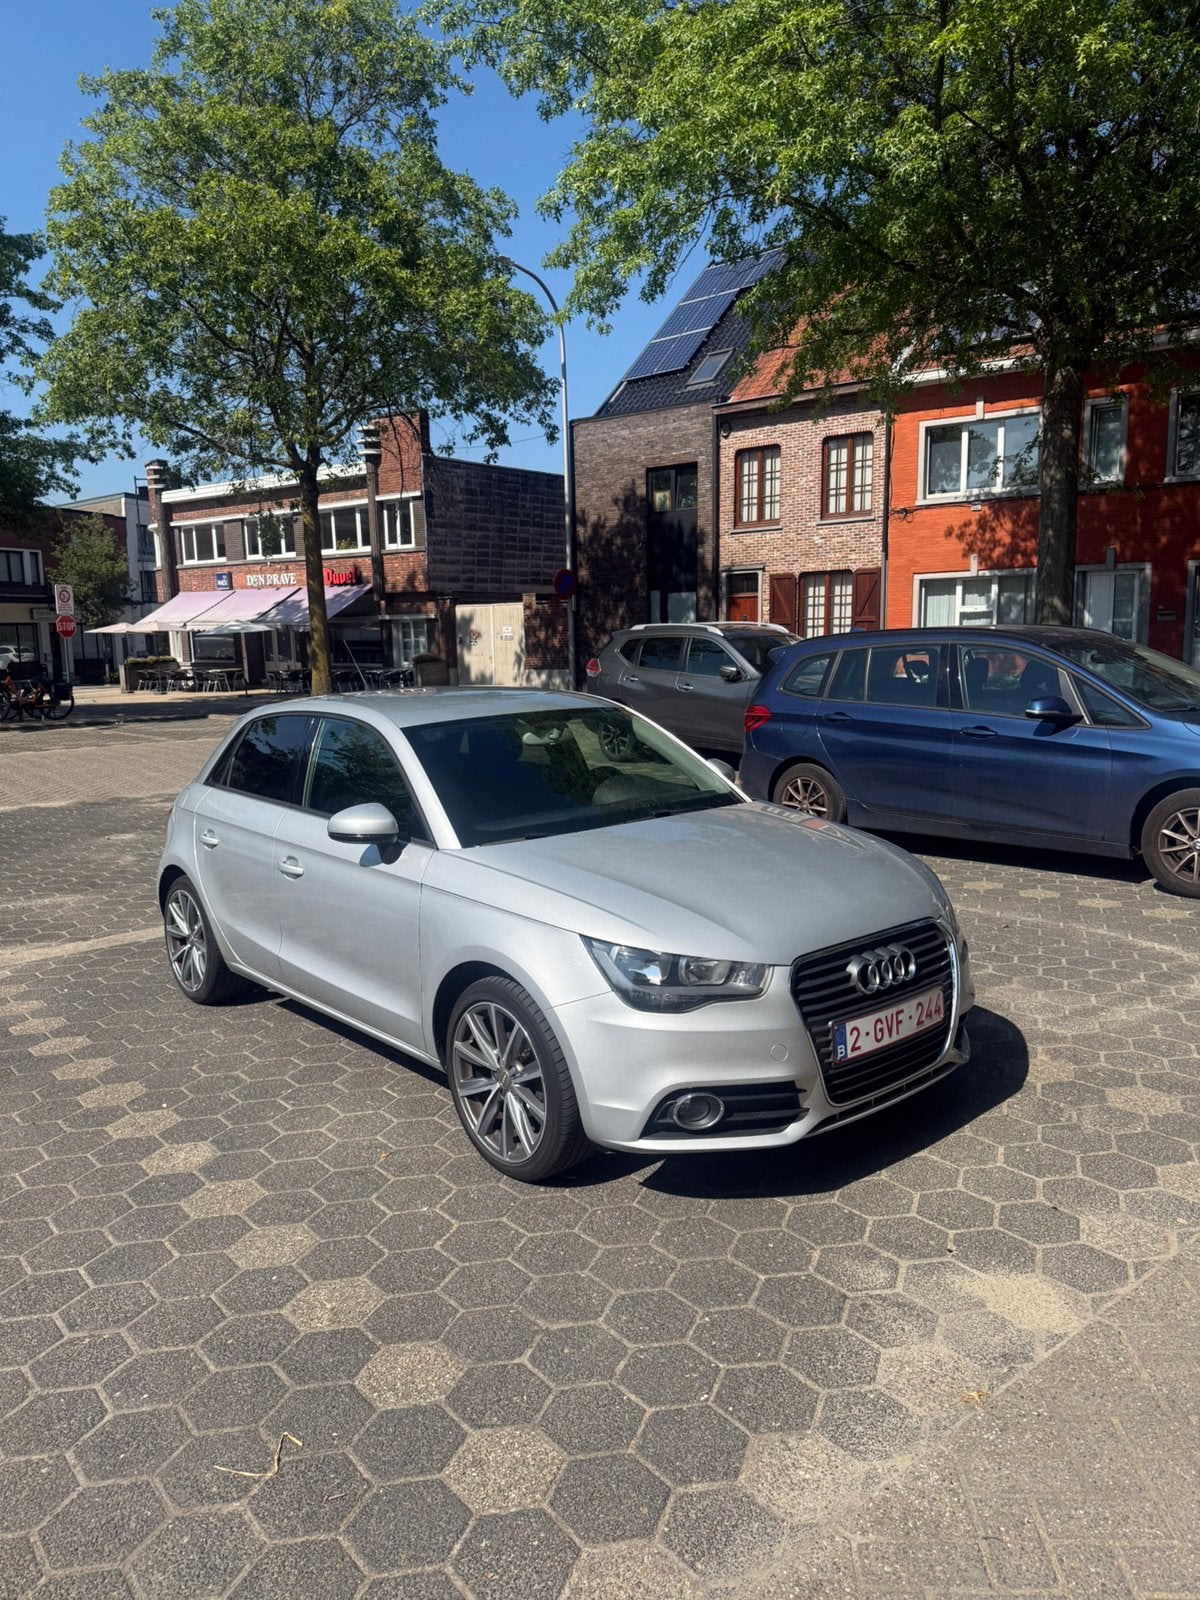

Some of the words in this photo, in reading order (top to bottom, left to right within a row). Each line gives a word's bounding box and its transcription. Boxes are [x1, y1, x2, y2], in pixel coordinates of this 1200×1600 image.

[246, 574, 265, 586] DEN
[323, 567, 356, 585] Duvel
[58, 622, 75, 631] STOP
[849, 991, 943, 1053] 2-GVF-244
[837, 1045, 846, 1059] B
